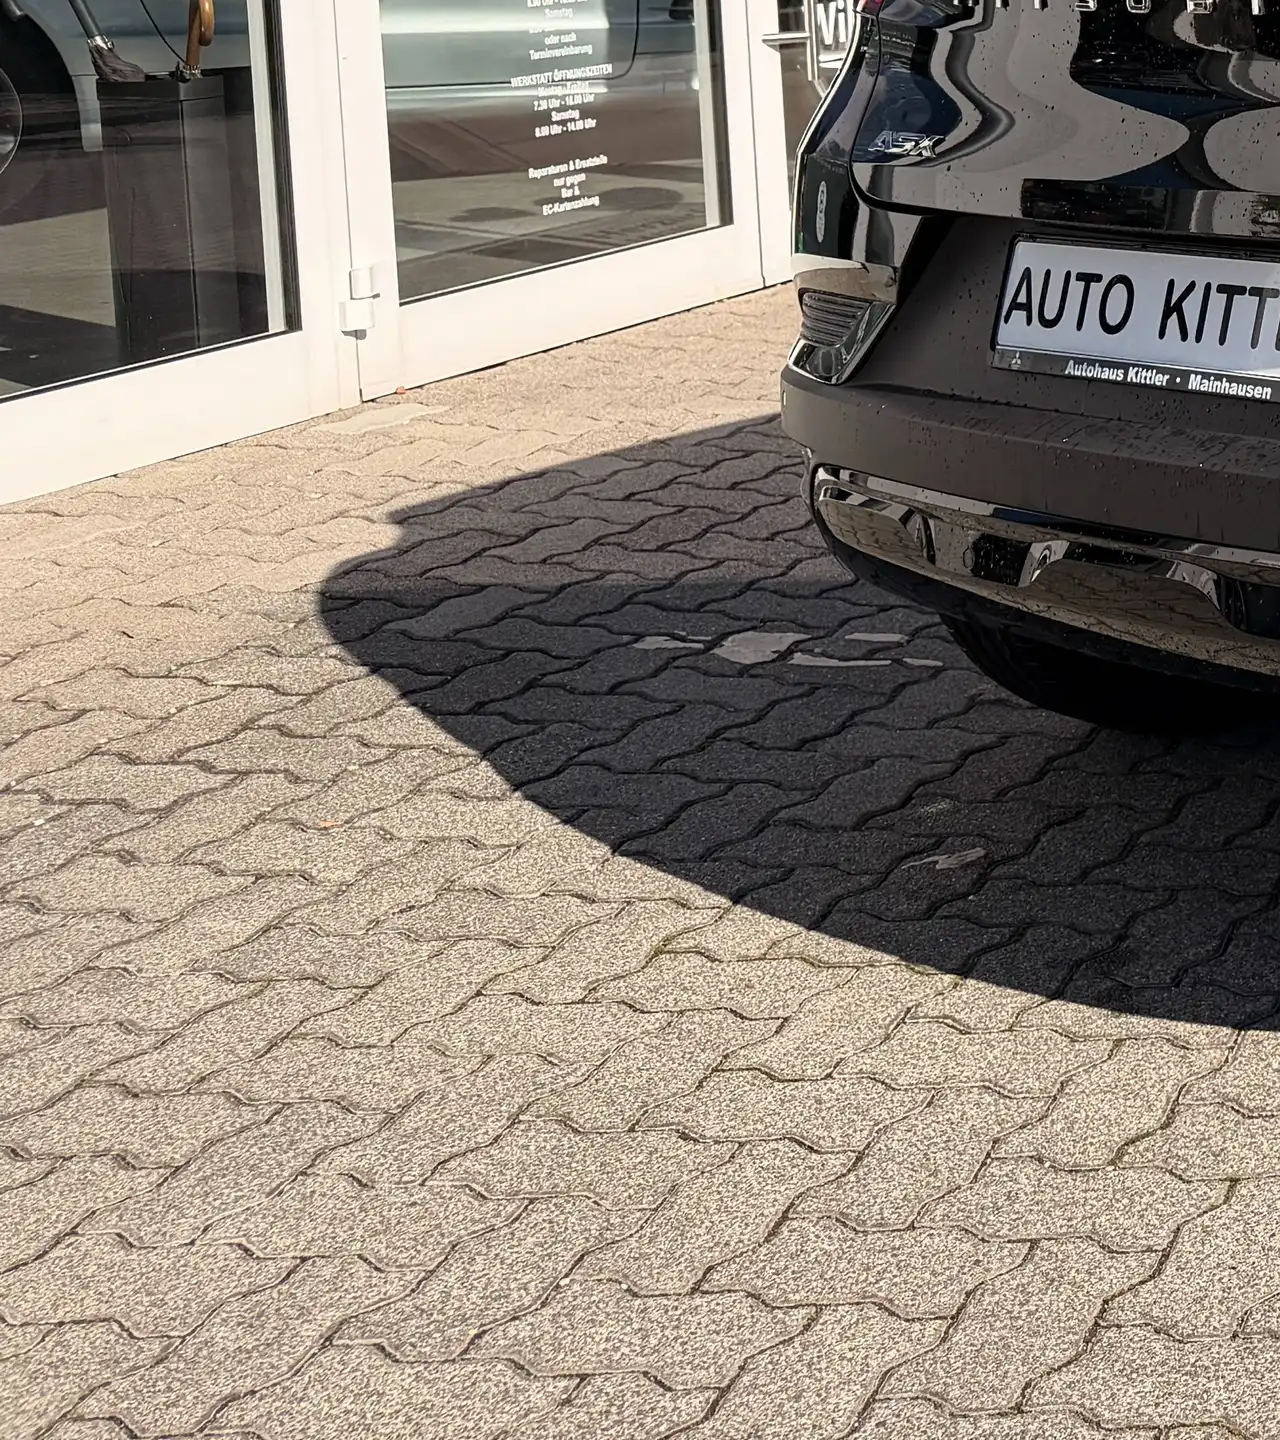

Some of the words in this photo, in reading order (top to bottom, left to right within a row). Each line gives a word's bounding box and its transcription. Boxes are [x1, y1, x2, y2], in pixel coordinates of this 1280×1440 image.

[510, 72, 552, 88] WERKSTATT
[867, 130, 945, 158] ASX
[1002, 265, 1135, 336] AUTO
[1064, 358, 1125, 382] Autohaus
[1126, 364, 1170, 387] Kittler
[1187, 373, 1272, 401] Mainhausen
